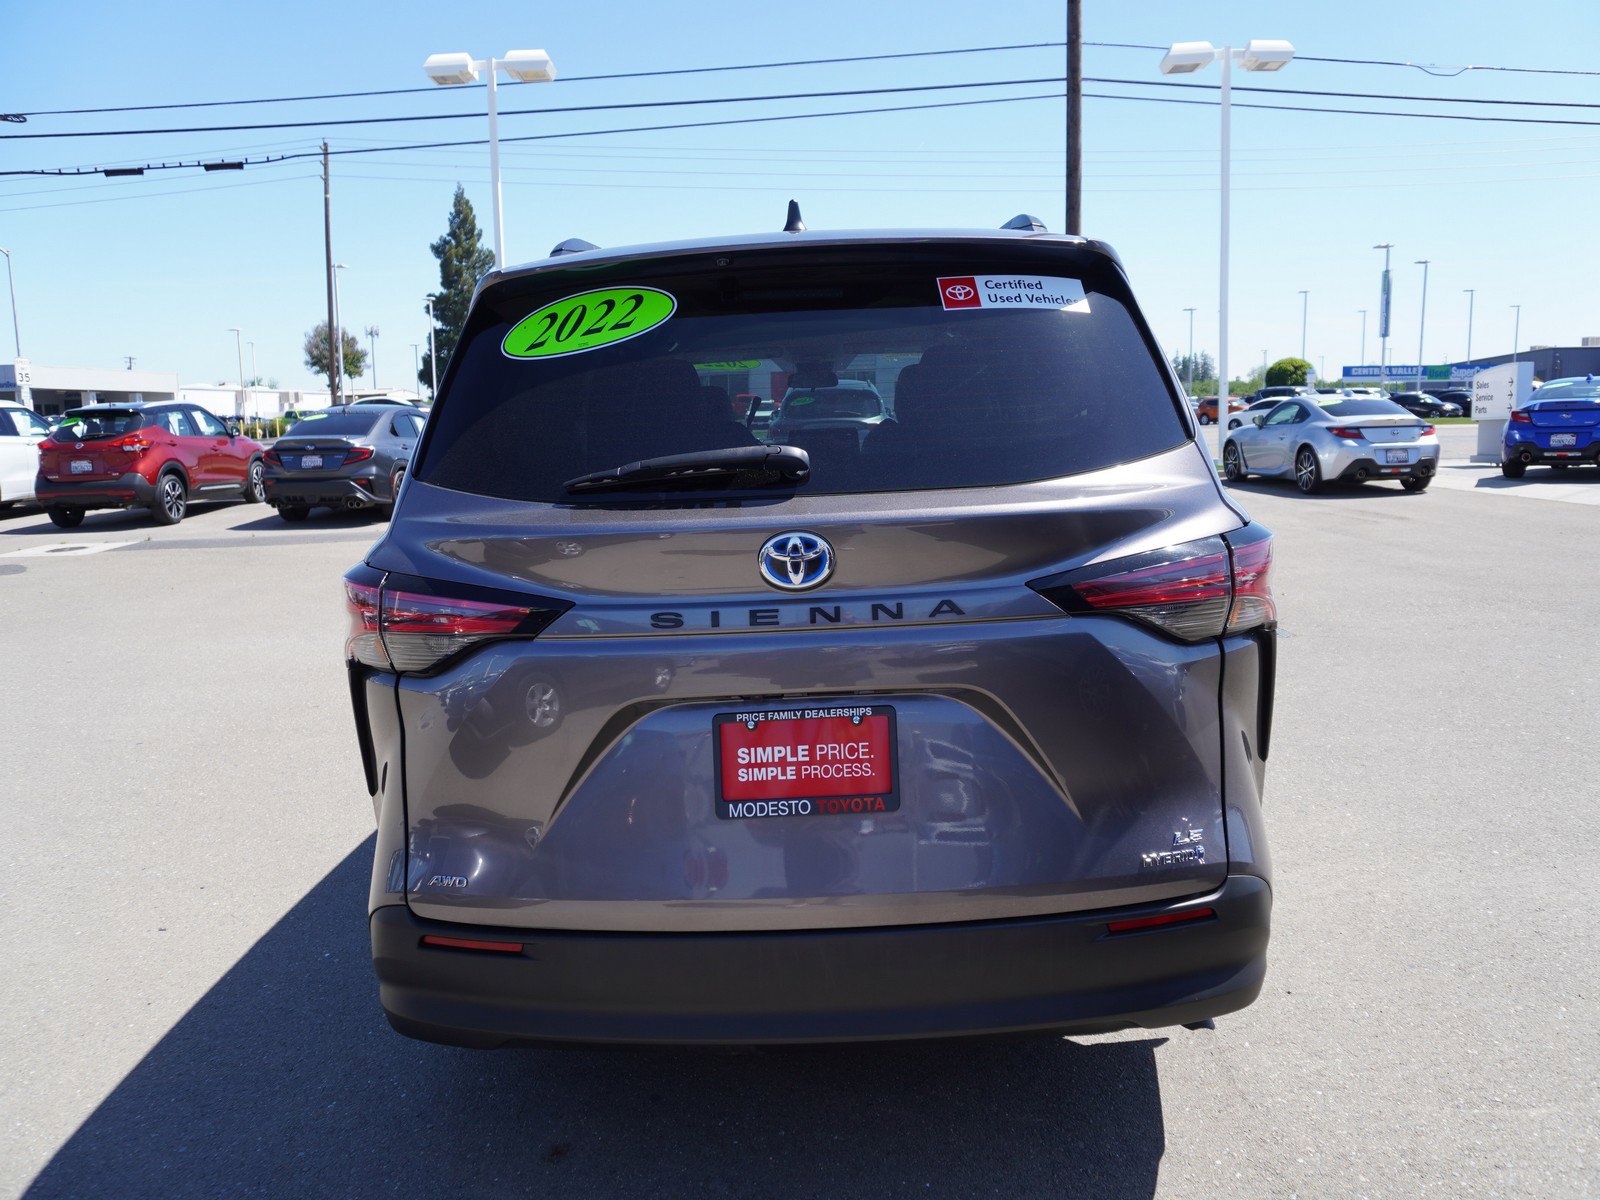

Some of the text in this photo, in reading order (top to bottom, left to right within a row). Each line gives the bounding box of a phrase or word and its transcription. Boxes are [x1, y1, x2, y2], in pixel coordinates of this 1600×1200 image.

[984, 279, 1043, 290] Certified
[988, 293, 1022, 303] Used
[524, 293, 644, 352] 2022
[18, 372, 31, 383] 35
[1392, 367, 1423, 375] VALLEY
[1429, 367, 1450, 377] Used
[1476, 381, 1490, 389] Sales
[650, 599, 966, 629] SIENNA
[736, 707, 873, 722] PRICE FAMILY DEALERSHIPS
[737, 742, 875, 765] SIMPLE PRICE.
[737, 763, 876, 782] SIMPLE PROCESS.
[729, 797, 886, 818] MODESTO TOYOTA
[427, 875, 468, 888] AWD
